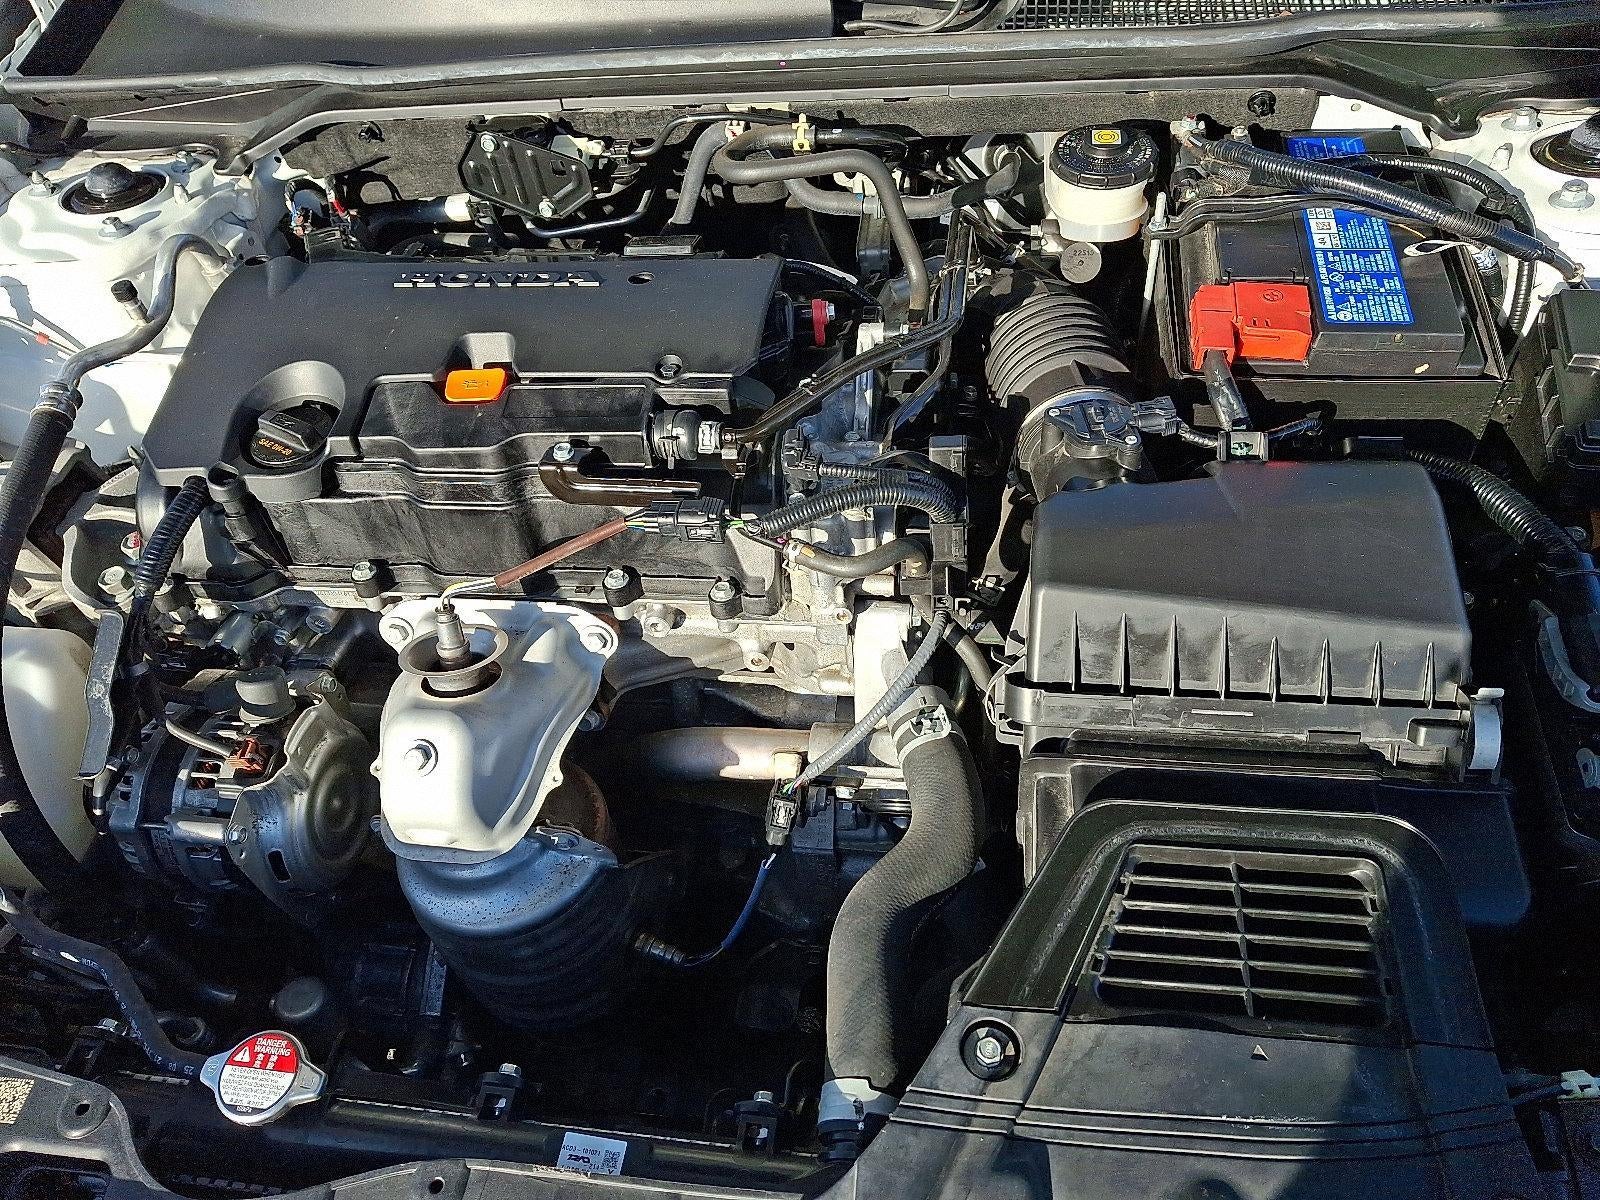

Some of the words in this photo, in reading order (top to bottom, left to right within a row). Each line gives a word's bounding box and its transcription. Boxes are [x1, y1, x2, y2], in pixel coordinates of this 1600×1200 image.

[393, 270, 604, 288] HONDA
[258, 438, 274, 448] SAE
[256, 1038, 287, 1048] DANGER
[254, 1045, 291, 1056] WARNUNG
